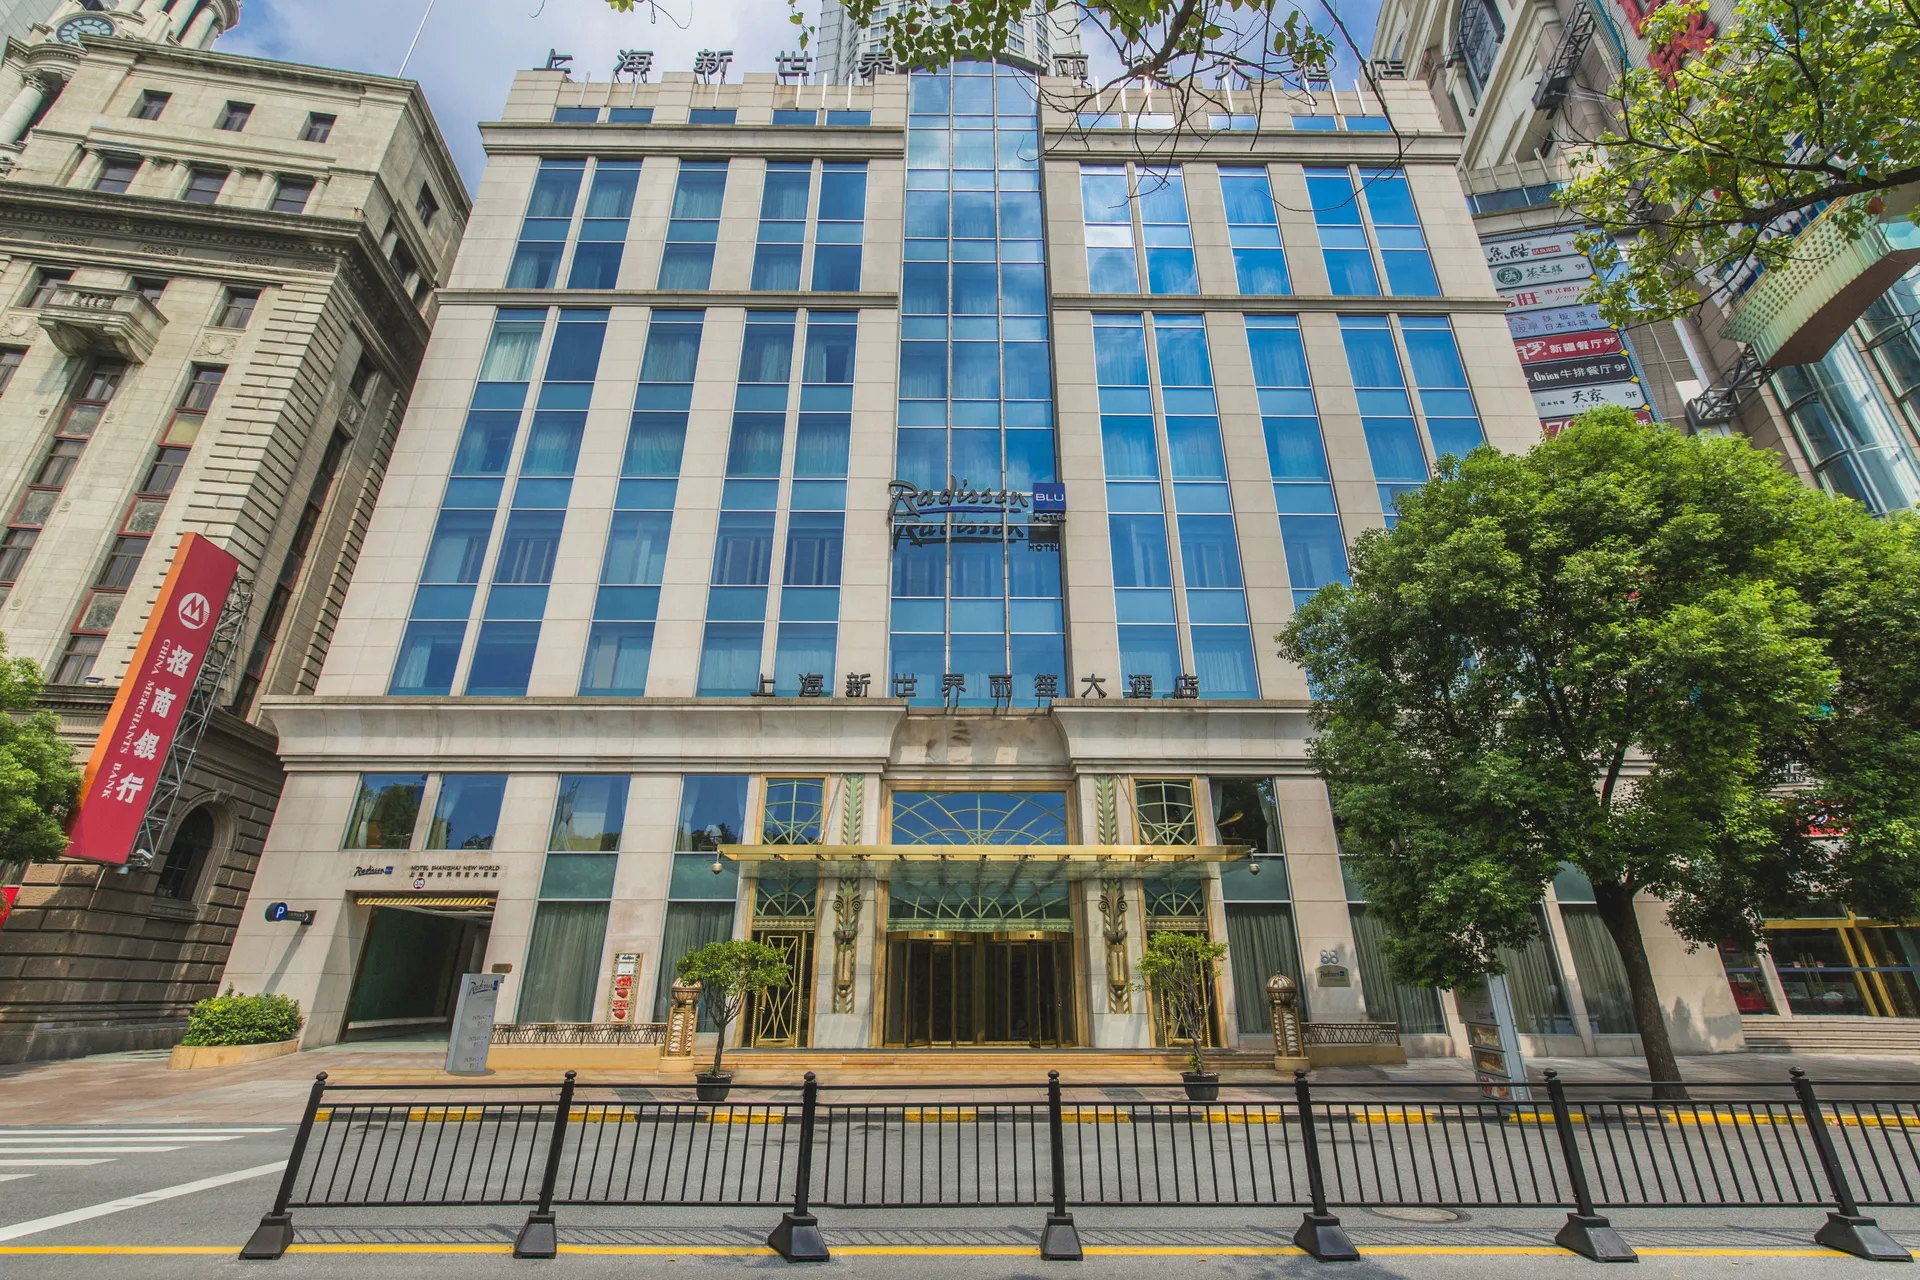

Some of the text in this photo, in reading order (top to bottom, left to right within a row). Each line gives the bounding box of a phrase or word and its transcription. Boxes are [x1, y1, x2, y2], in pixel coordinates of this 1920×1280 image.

[1545, 319, 1589, 331] 日本料理
[1549, 339, 1602, 354] 新疆餐厅
[1603, 337, 1616, 345] 9F
[1560, 364, 1611, 379] 牛排餐厅
[1614, 363, 1627, 372] 9F
[1625, 391, 1637, 399] 9F
[888, 475, 1064, 522] Radisson BLU
[1033, 513, 1066, 523] HOTEL
[751, 672, 1200, 699] 上海新世界丽笙大酒店
[101, 638, 171, 799] CHINA MERCHANTS BANK
[276, 906, 285, 919] P
